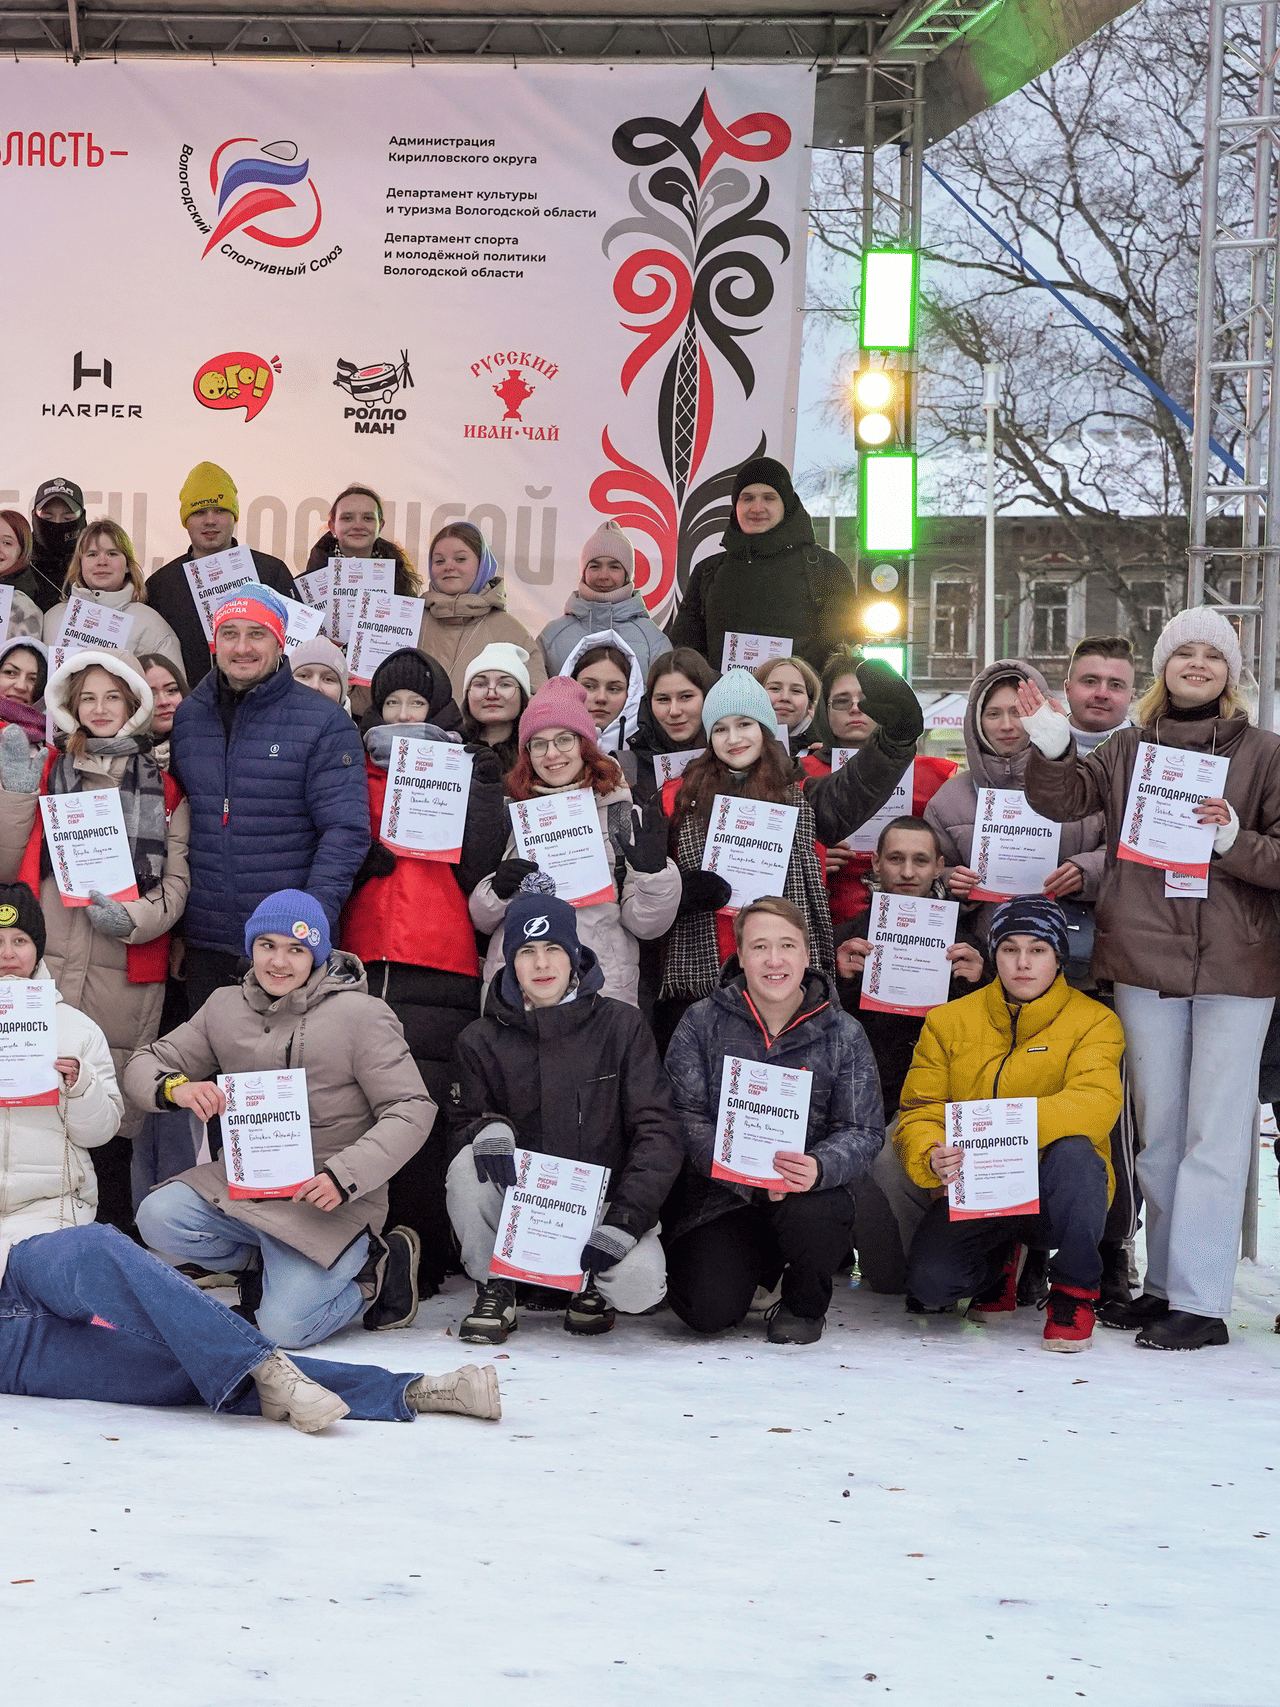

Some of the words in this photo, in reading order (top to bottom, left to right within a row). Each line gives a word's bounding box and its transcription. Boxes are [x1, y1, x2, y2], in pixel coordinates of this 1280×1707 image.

[388, 136, 495, 148] Администрация
[388, 152, 489, 164] Кирилловского
[493, 154, 537, 166] округа
[386, 187, 473, 199] Департамент
[476, 191, 538, 201] культуры
[386, 206, 394, 214] и
[397, 206, 452, 216] туризма
[455, 205, 540, 217] Вологодской
[543, 207, 597, 218] области
[384, 232, 471, 244] Департамент
[474, 236, 519, 246] спорта
[384, 251, 392, 259] и
[396, 250, 479, 261] молодёжной
[483, 253, 547, 262] политики
[383, 266, 467, 277] Вологодской
[471, 267, 524, 278] области
[470, 350, 559, 381] РУССКИЙ
[42, 403, 143, 418] HARPER
[344, 407, 407, 421] РОЛЛО
[354, 422, 395, 434] МАН
[357, 620, 413, 636] БЛАГОДАРНОСТЬ
[394, 776, 462, 792] БЛАГОДАРНОСТЬ
[53, 827, 119, 841] БЛАГОДАРНОСТЬ
[523, 825, 593, 846] БЛАГОДАРНОСТЬ
[981, 824, 1053, 837] БЛАГОДАРНОСТЬ
[714, 833, 783, 853] БЛАГОДАРНОСТЬ
[875, 931, 946, 948] БЛАГОДАРНОСТЬ
[727, 1098, 799, 1120] БЛАГОДАРНОСТЬ
[227, 1111, 300, 1125] БЛАГОДАРНОСТЬ
[513, 1190, 587, 1216] БЛАГОДАРНОСТЬ
